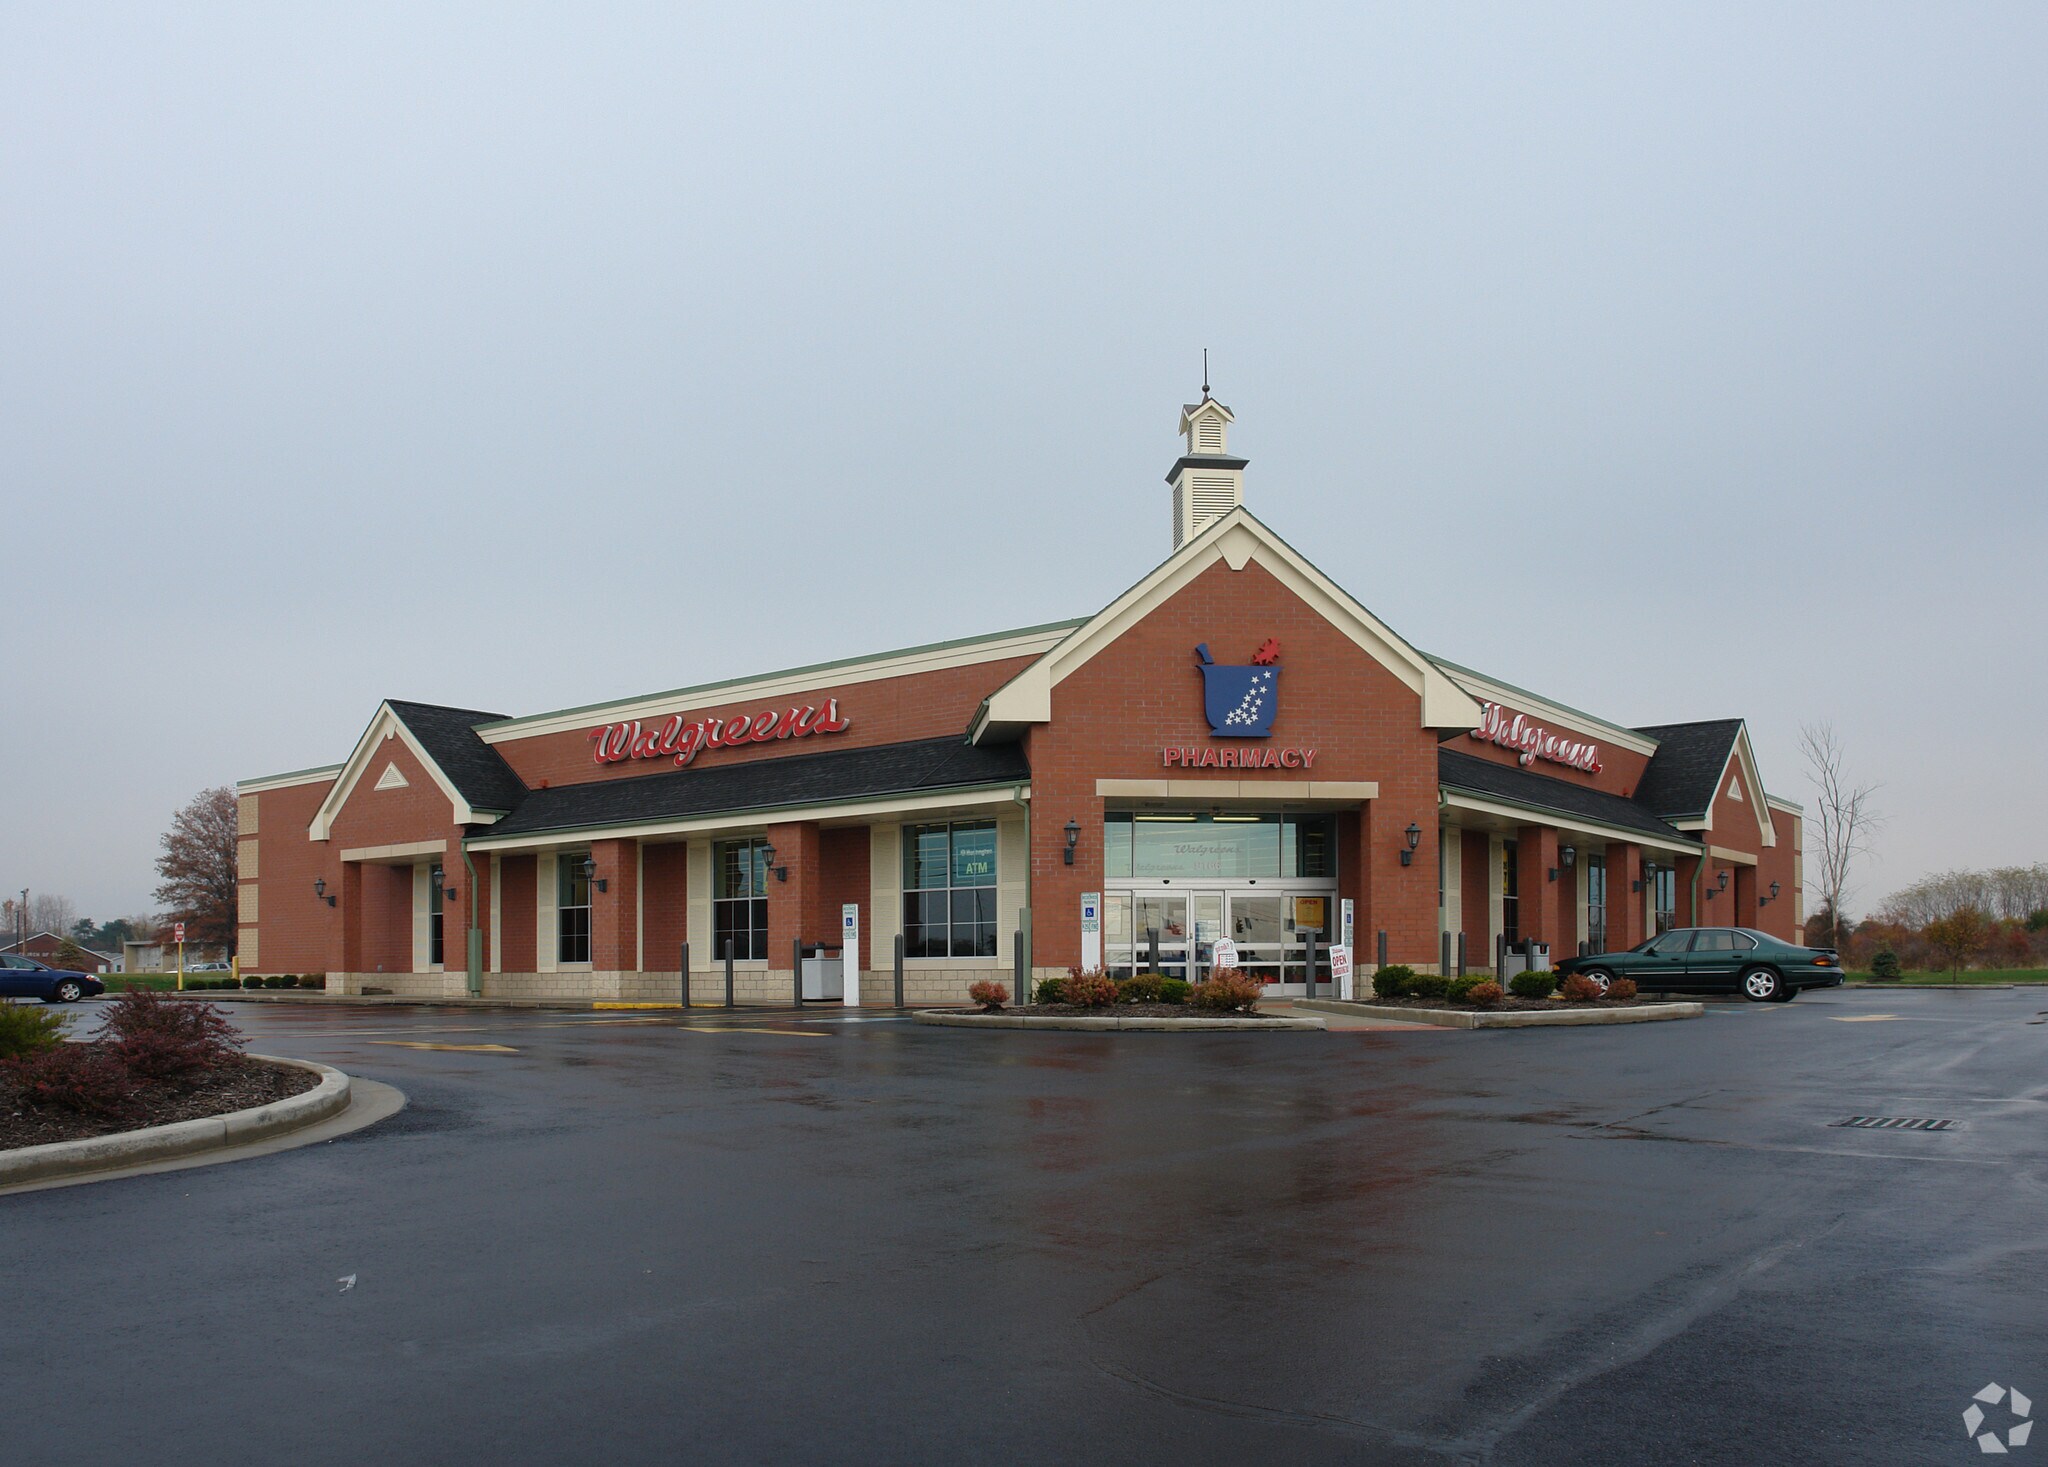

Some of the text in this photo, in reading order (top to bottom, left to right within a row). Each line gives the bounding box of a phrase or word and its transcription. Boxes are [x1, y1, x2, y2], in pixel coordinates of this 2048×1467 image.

[586, 698, 850, 767] Walgreens
[1470, 702, 1603, 773] Walgreens
[1164, 747, 1318, 769] PHARMACY
[1174, 844, 1242, 857] Walgreens
[965, 861, 988, 875] ATM
[1332, 955, 1347, 967] OPEN
